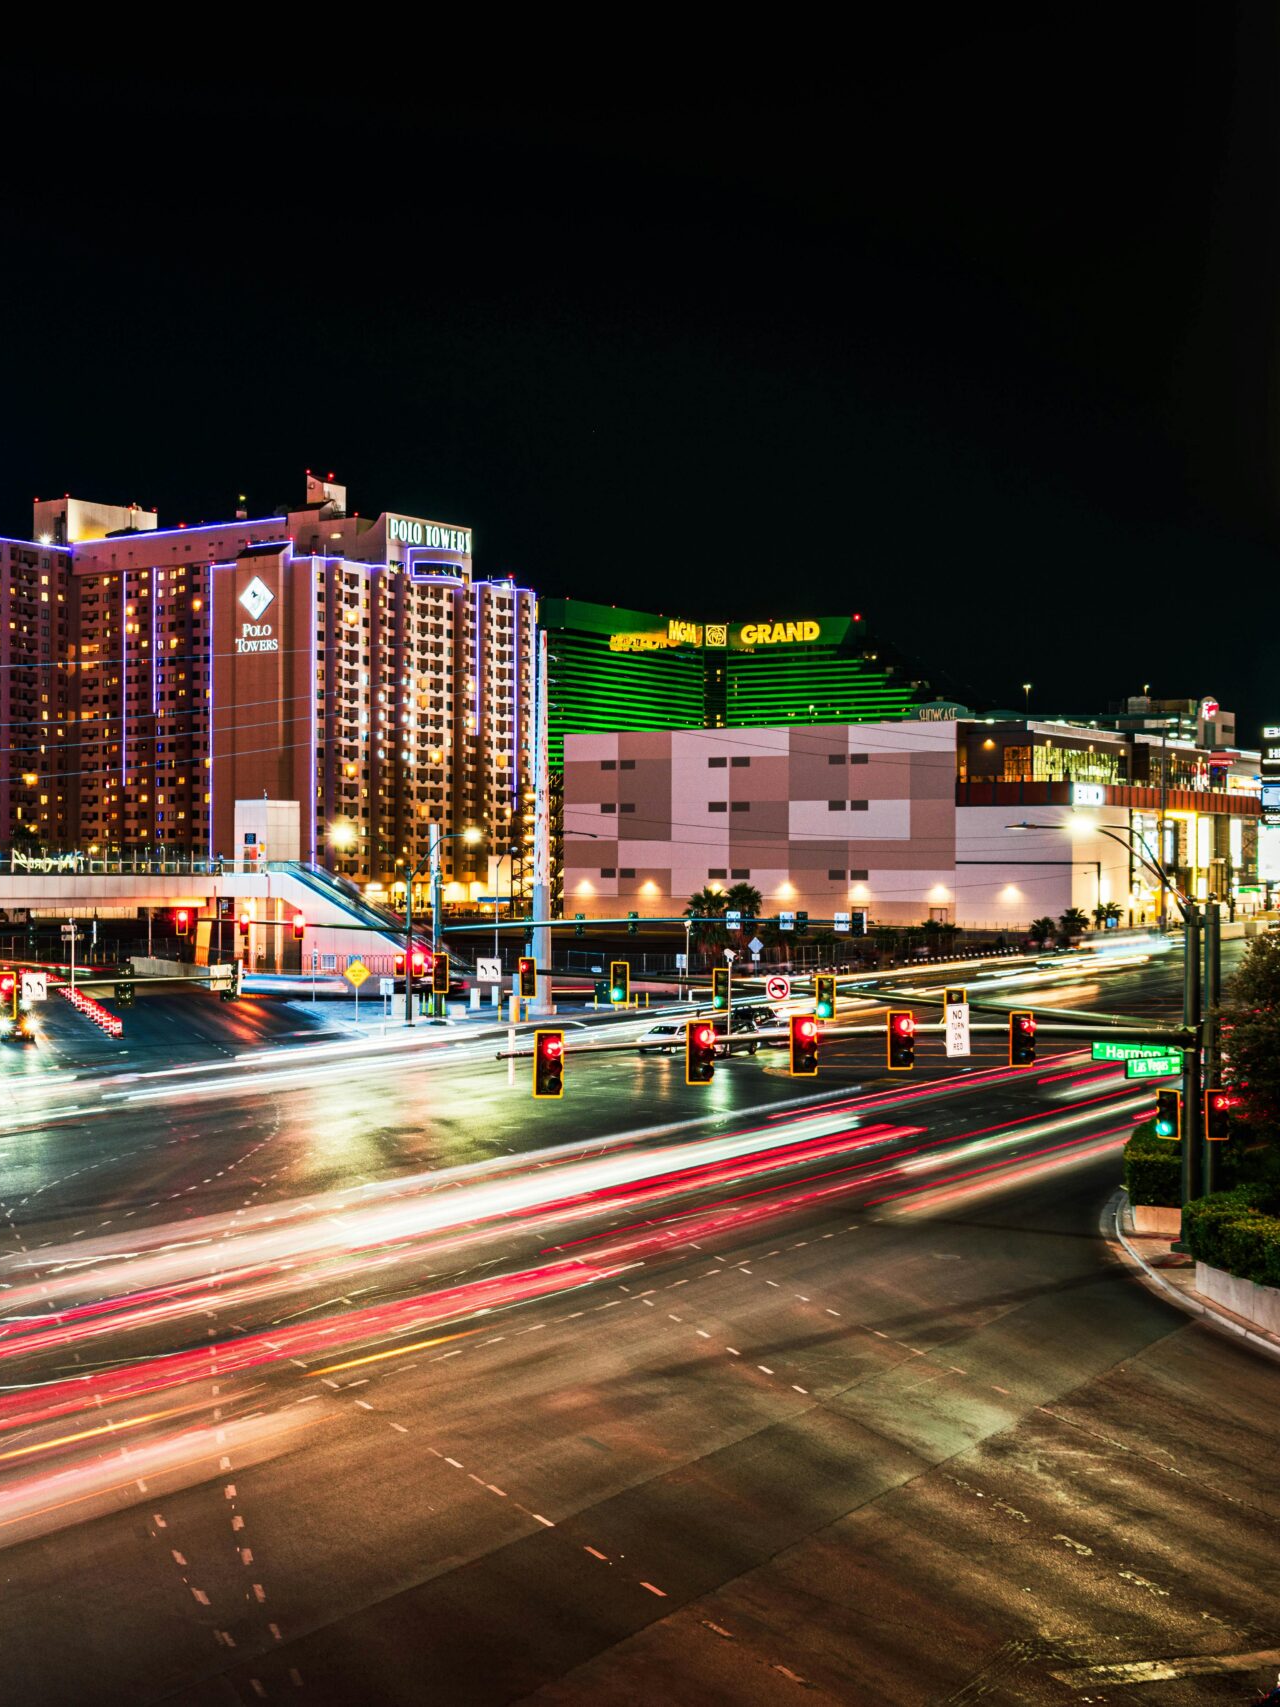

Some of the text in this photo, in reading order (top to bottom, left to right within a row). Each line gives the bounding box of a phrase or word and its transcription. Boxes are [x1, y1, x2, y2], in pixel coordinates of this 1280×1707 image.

[389, 518, 471, 554] POLO TOWERS
[242, 623, 272, 638] POLO
[668, 619, 820, 644] MGM GRAND
[235, 637, 279, 653] TOWERS
[952, 1009, 963, 1020] NO
[951, 1022, 965, 1030] TURN
[954, 1032, 962, 1041] ON
[1105, 1045, 1162, 1059] Harmon
[1133, 1059, 1147, 1073] Las
[1147, 1058, 1169, 1075] Vegas
